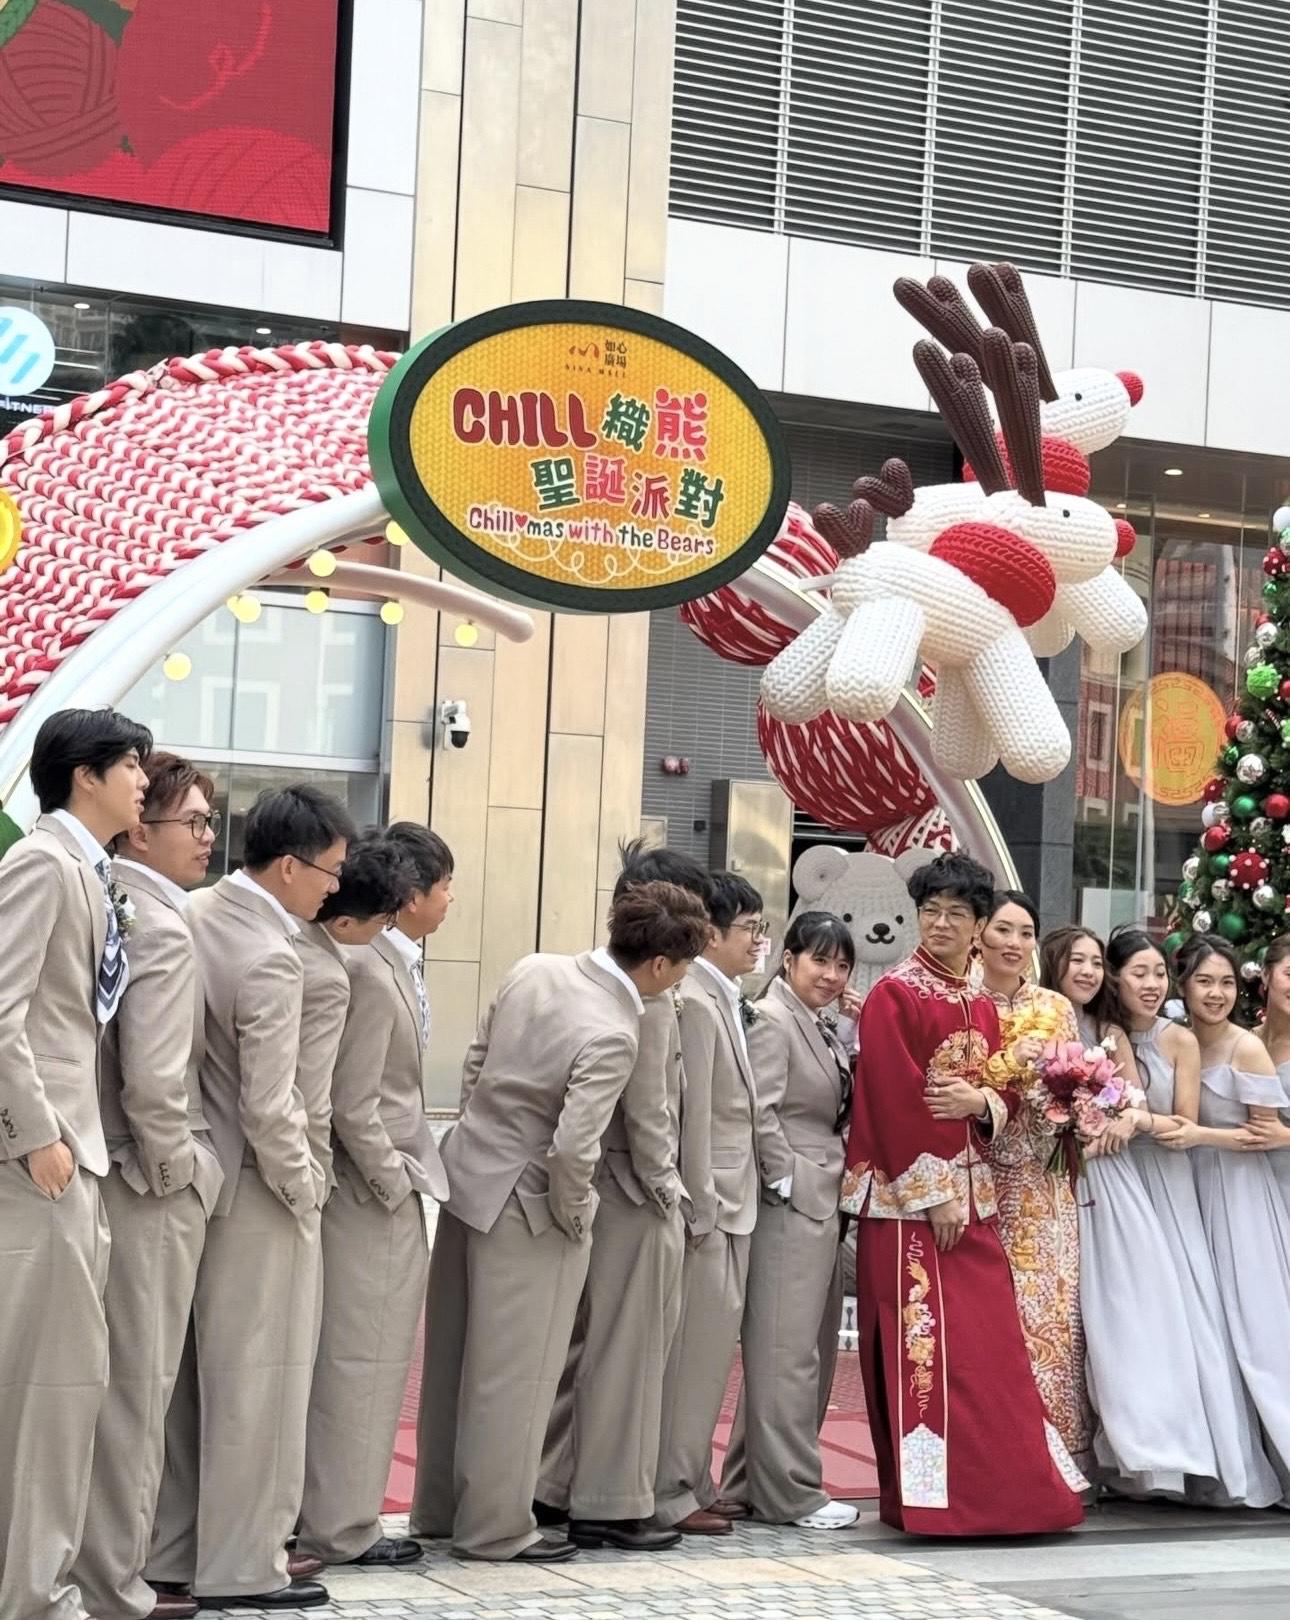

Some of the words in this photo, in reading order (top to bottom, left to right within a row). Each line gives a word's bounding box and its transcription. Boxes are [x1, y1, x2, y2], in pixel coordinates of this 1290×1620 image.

[453, 387, 598, 448] CHILL
[601, 387, 708, 462] 織熊
[530, 454, 725, 529] 聖誕派對
[568, 522, 614, 545] with
[618, 525, 654, 549] the
[657, 528, 715, 556] Bears
